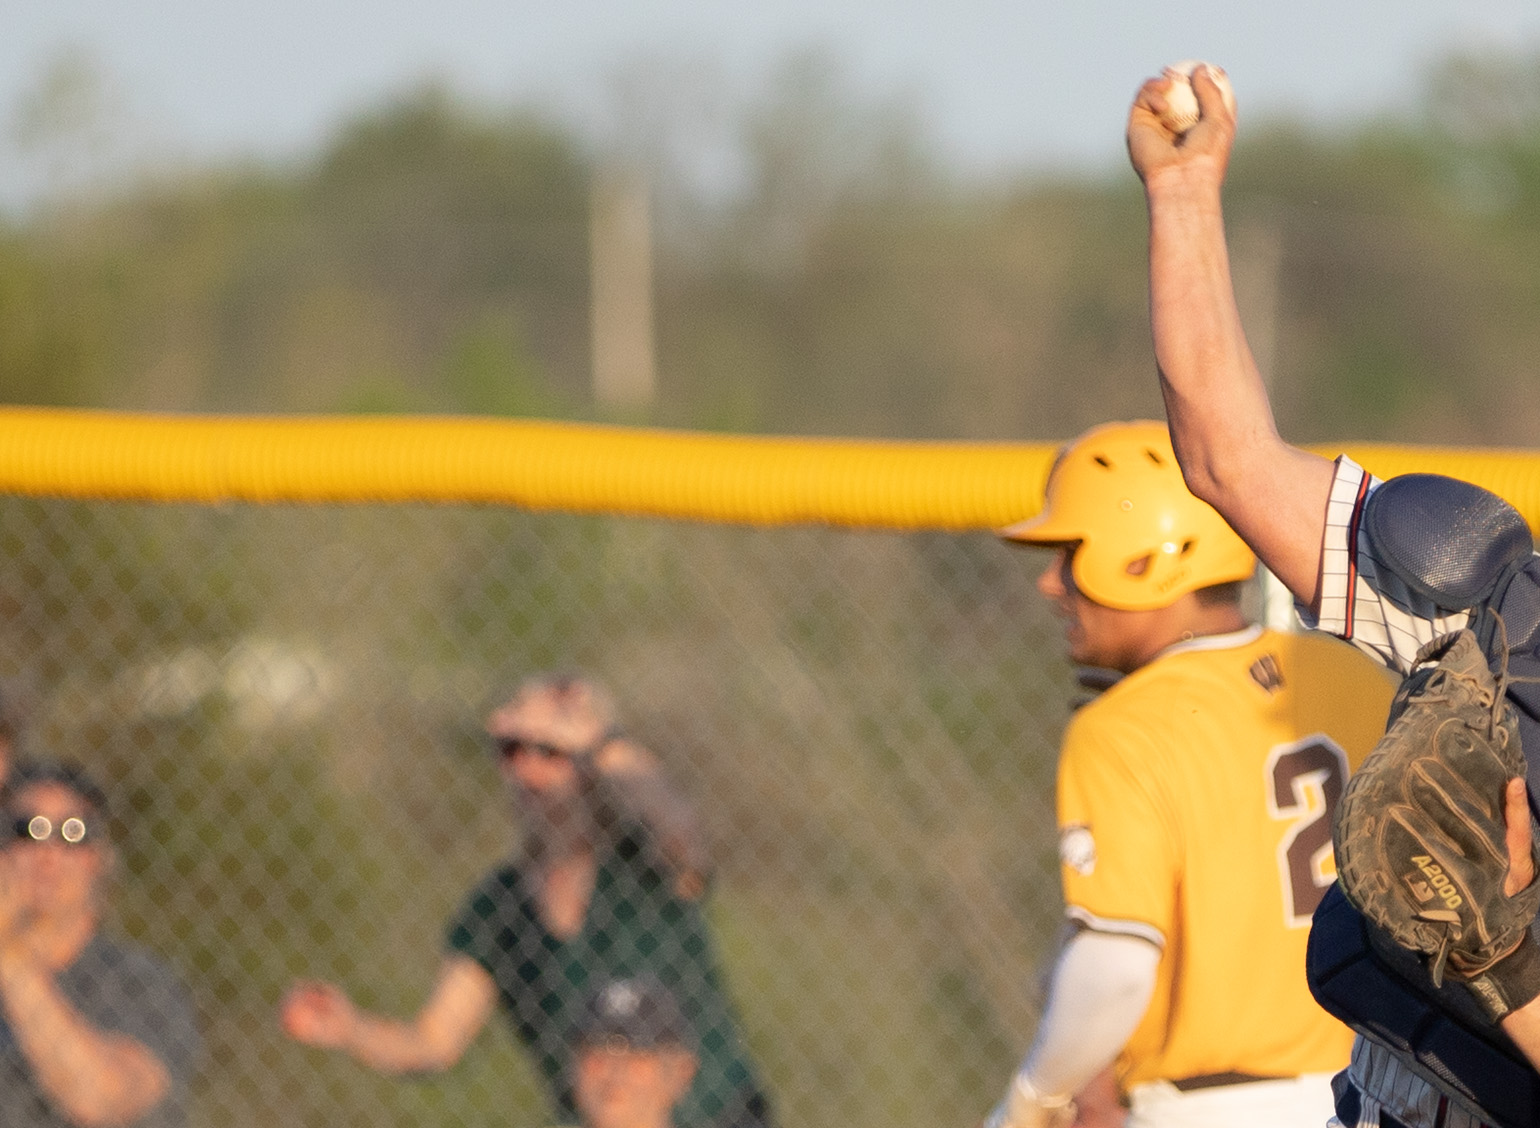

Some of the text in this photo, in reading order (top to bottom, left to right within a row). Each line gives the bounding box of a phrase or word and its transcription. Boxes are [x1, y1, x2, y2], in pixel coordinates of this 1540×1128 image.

[1249, 653, 1284, 695] W
[1263, 733, 1351, 928] 2
[1411, 855, 1463, 910] A2000
